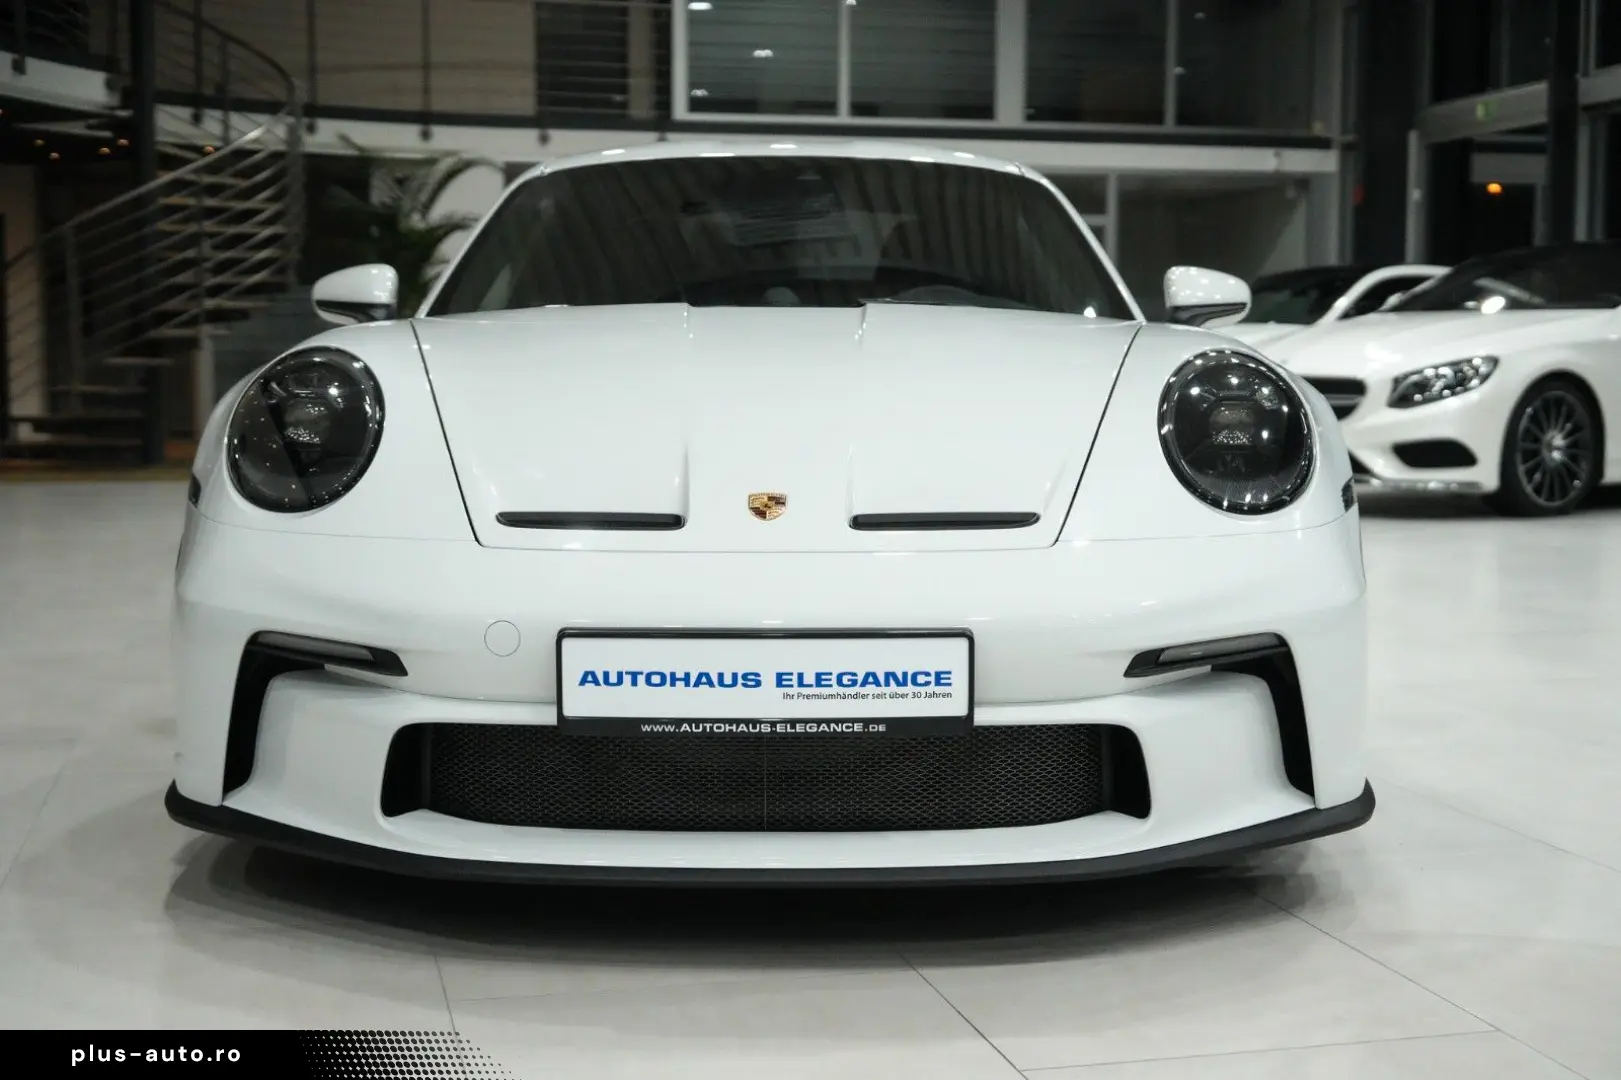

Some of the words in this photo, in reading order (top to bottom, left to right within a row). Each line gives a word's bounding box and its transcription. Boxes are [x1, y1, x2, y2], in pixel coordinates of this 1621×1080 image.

[578, 670, 762, 688] AUTOHAUS
[775, 670, 952, 688] ELEGANCE
[782, 692, 795, 700] Ihr
[797, 691, 869, 701] Premiumhändler
[871, 691, 887, 700] seit
[889, 690, 909, 699] über
[911, 691, 922, 699] 30
[924, 690, 952, 700] Jahren
[641, 722, 887, 733] www.AUTOHAUS-ELEGANCE.DE
